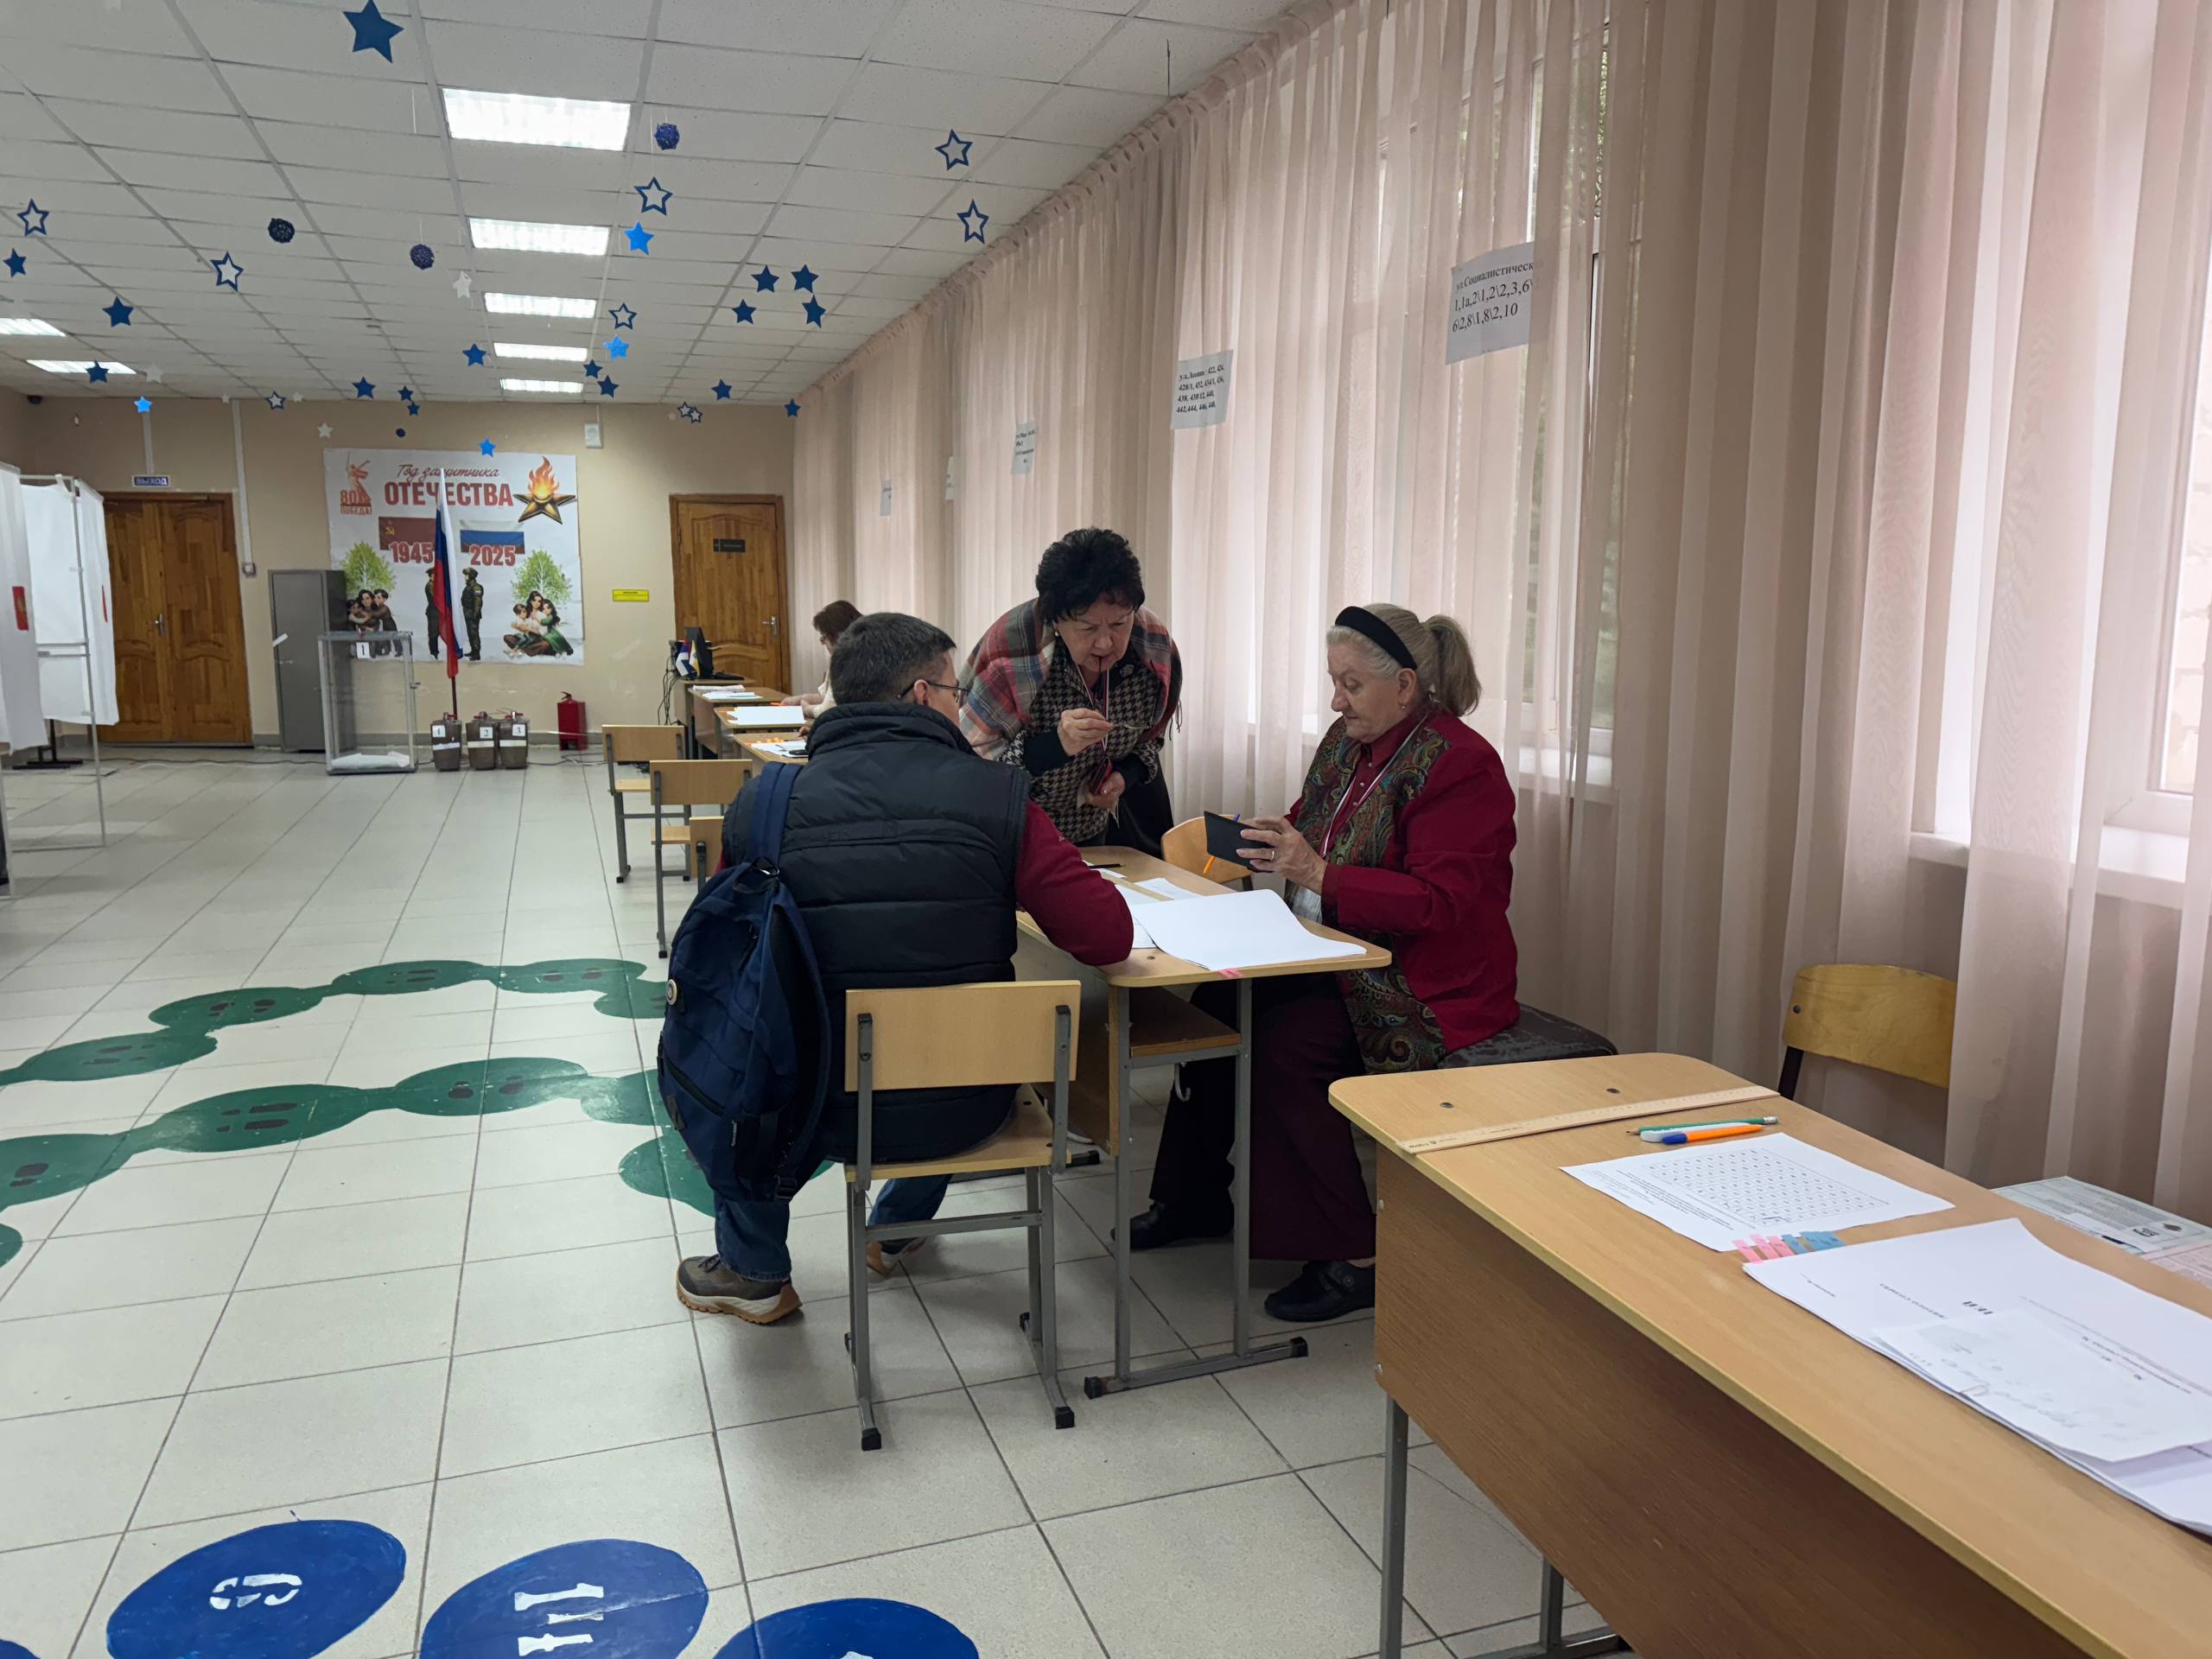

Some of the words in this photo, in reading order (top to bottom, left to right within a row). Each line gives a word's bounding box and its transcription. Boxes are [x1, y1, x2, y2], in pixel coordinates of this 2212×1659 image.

[397, 464, 419, 482] Год
[389, 541, 434, 563] 1945
[469, 544, 516, 567] 2025
